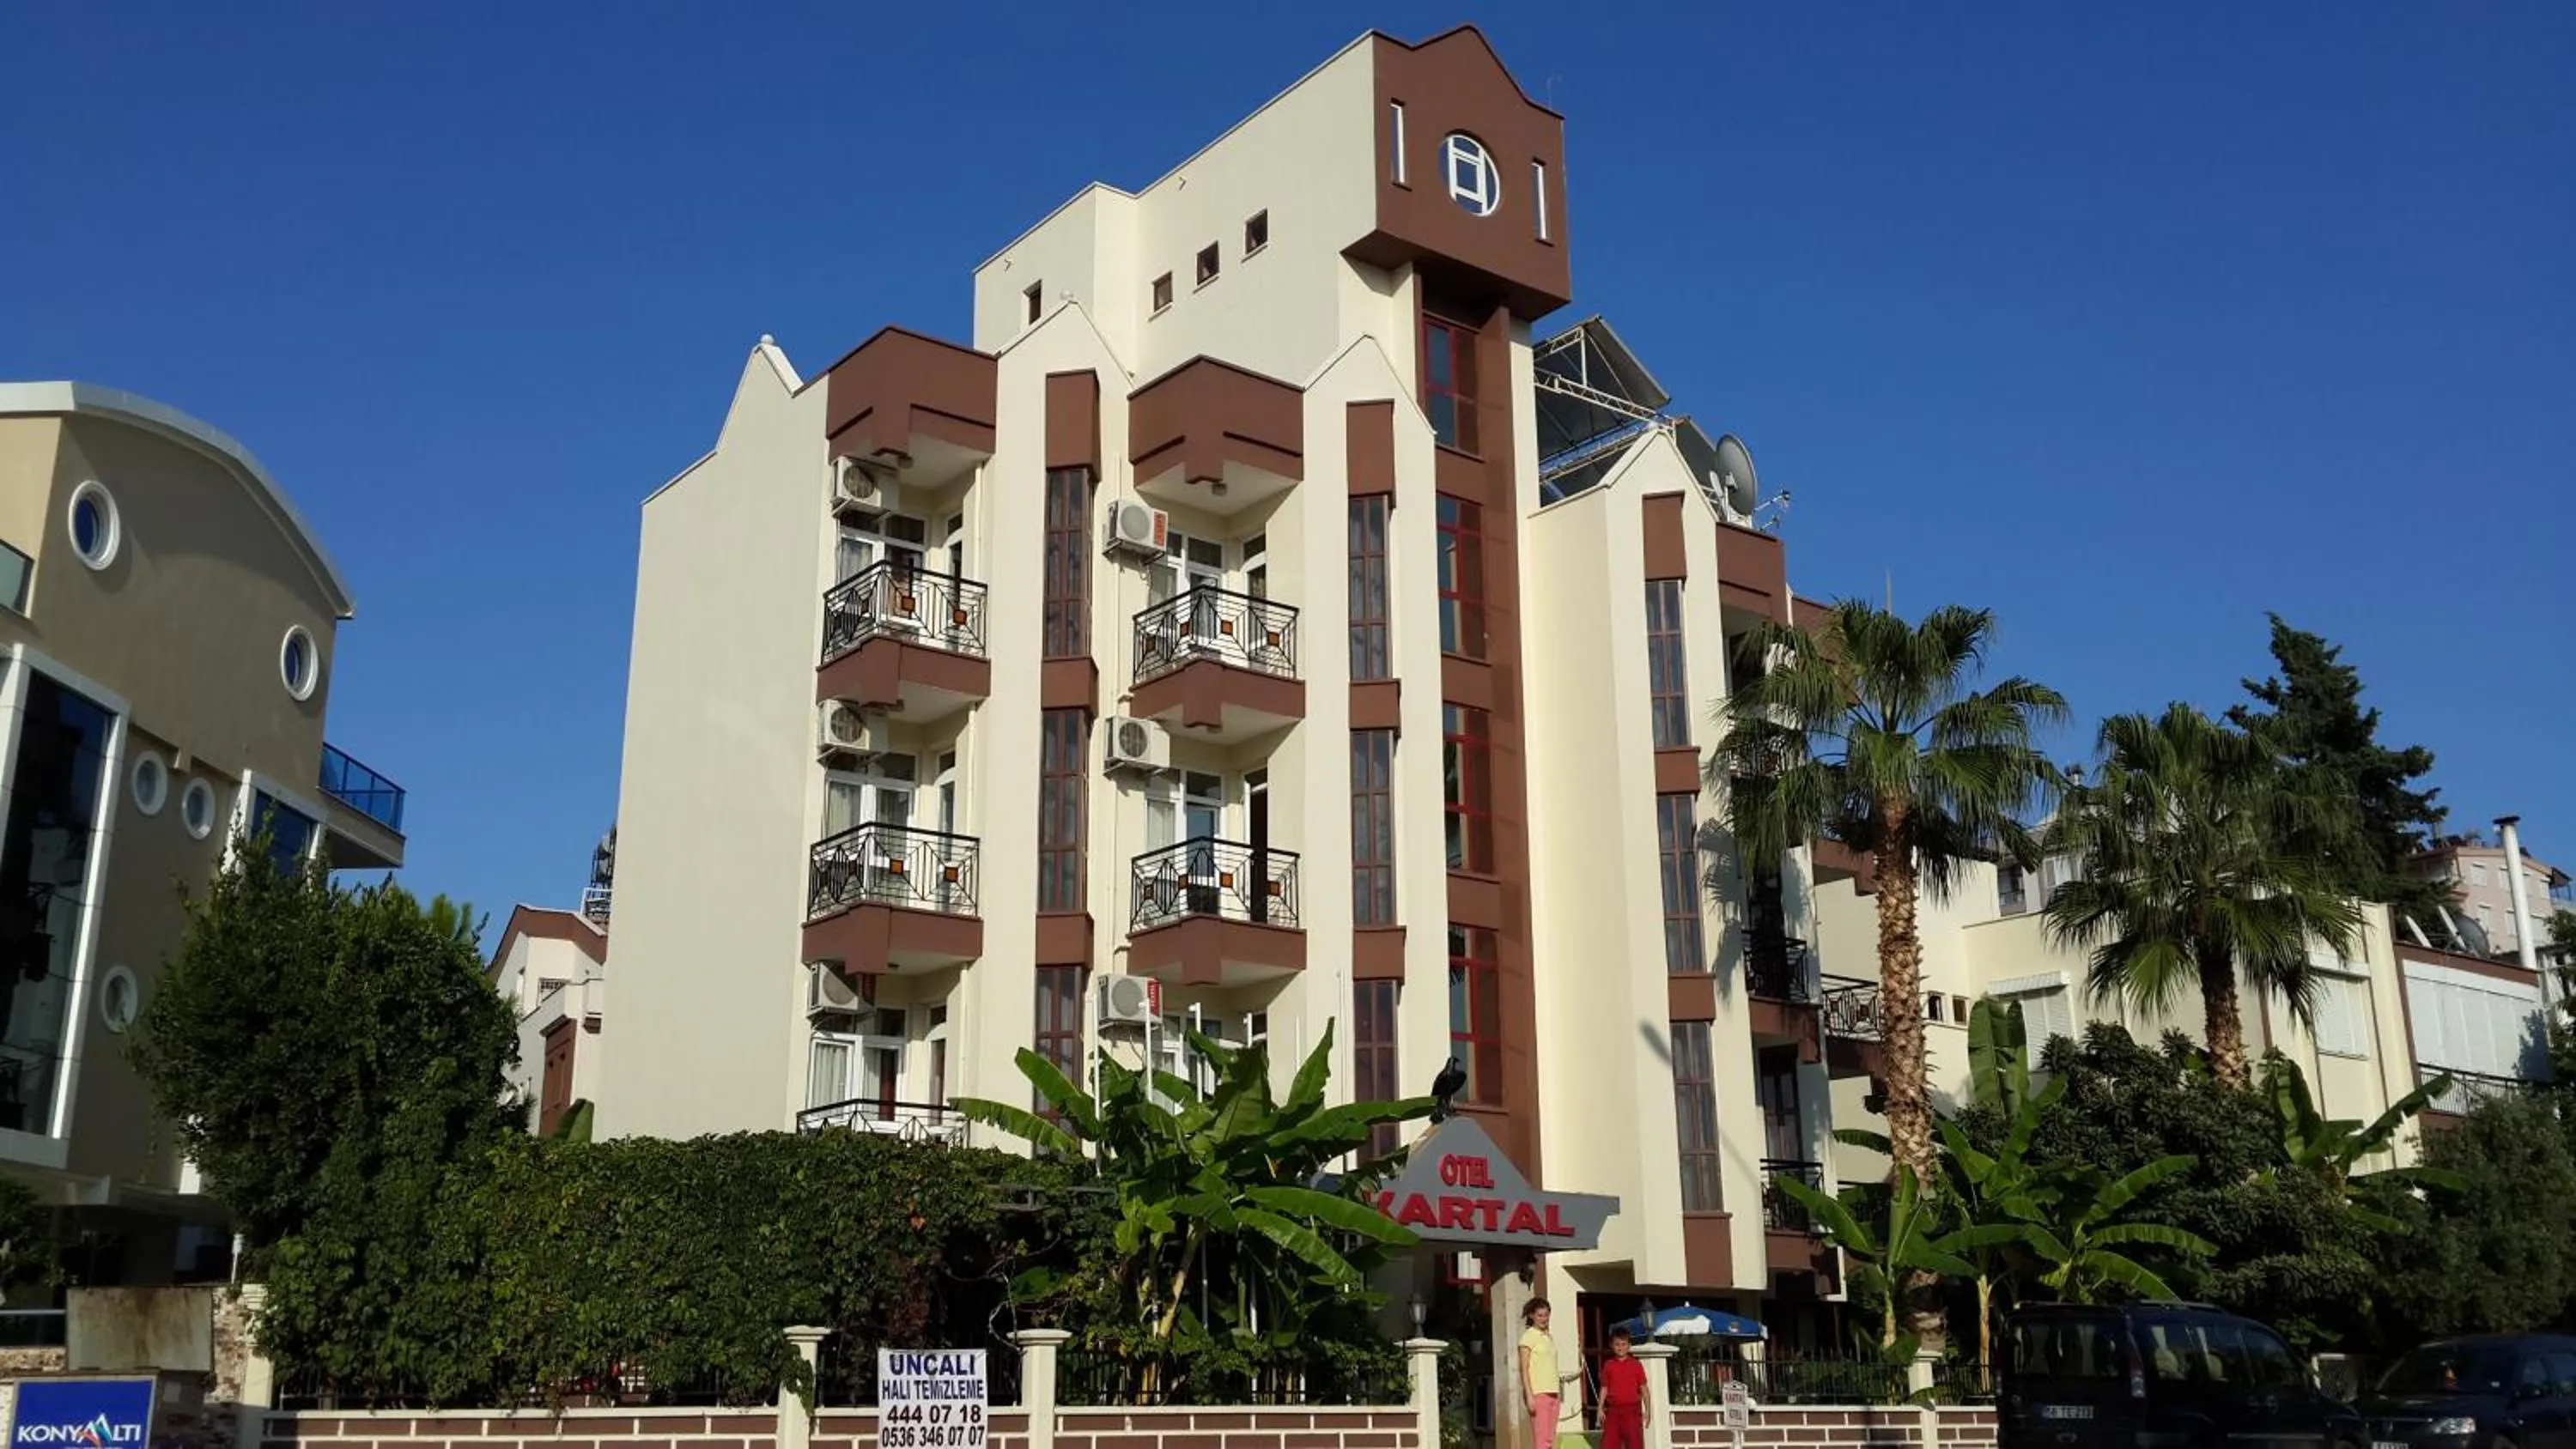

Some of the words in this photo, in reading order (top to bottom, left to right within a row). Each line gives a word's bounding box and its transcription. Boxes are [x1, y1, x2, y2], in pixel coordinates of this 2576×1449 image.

[1439, 1154, 1494, 1188] OTEL
[890, 1354, 975, 1376] UNCALI
[882, 1379, 911, 1400] HALI
[887, 1404, 923, 1424] 444
[929, 1404, 952, 1424] 07
[959, 1404, 981, 1423] 18
[882, 1426, 914, 1447] 0536
[920, 1426, 944, 1446] 346
[948, 1426, 964, 1446] 07
[969, 1425, 985, 1446] 07
